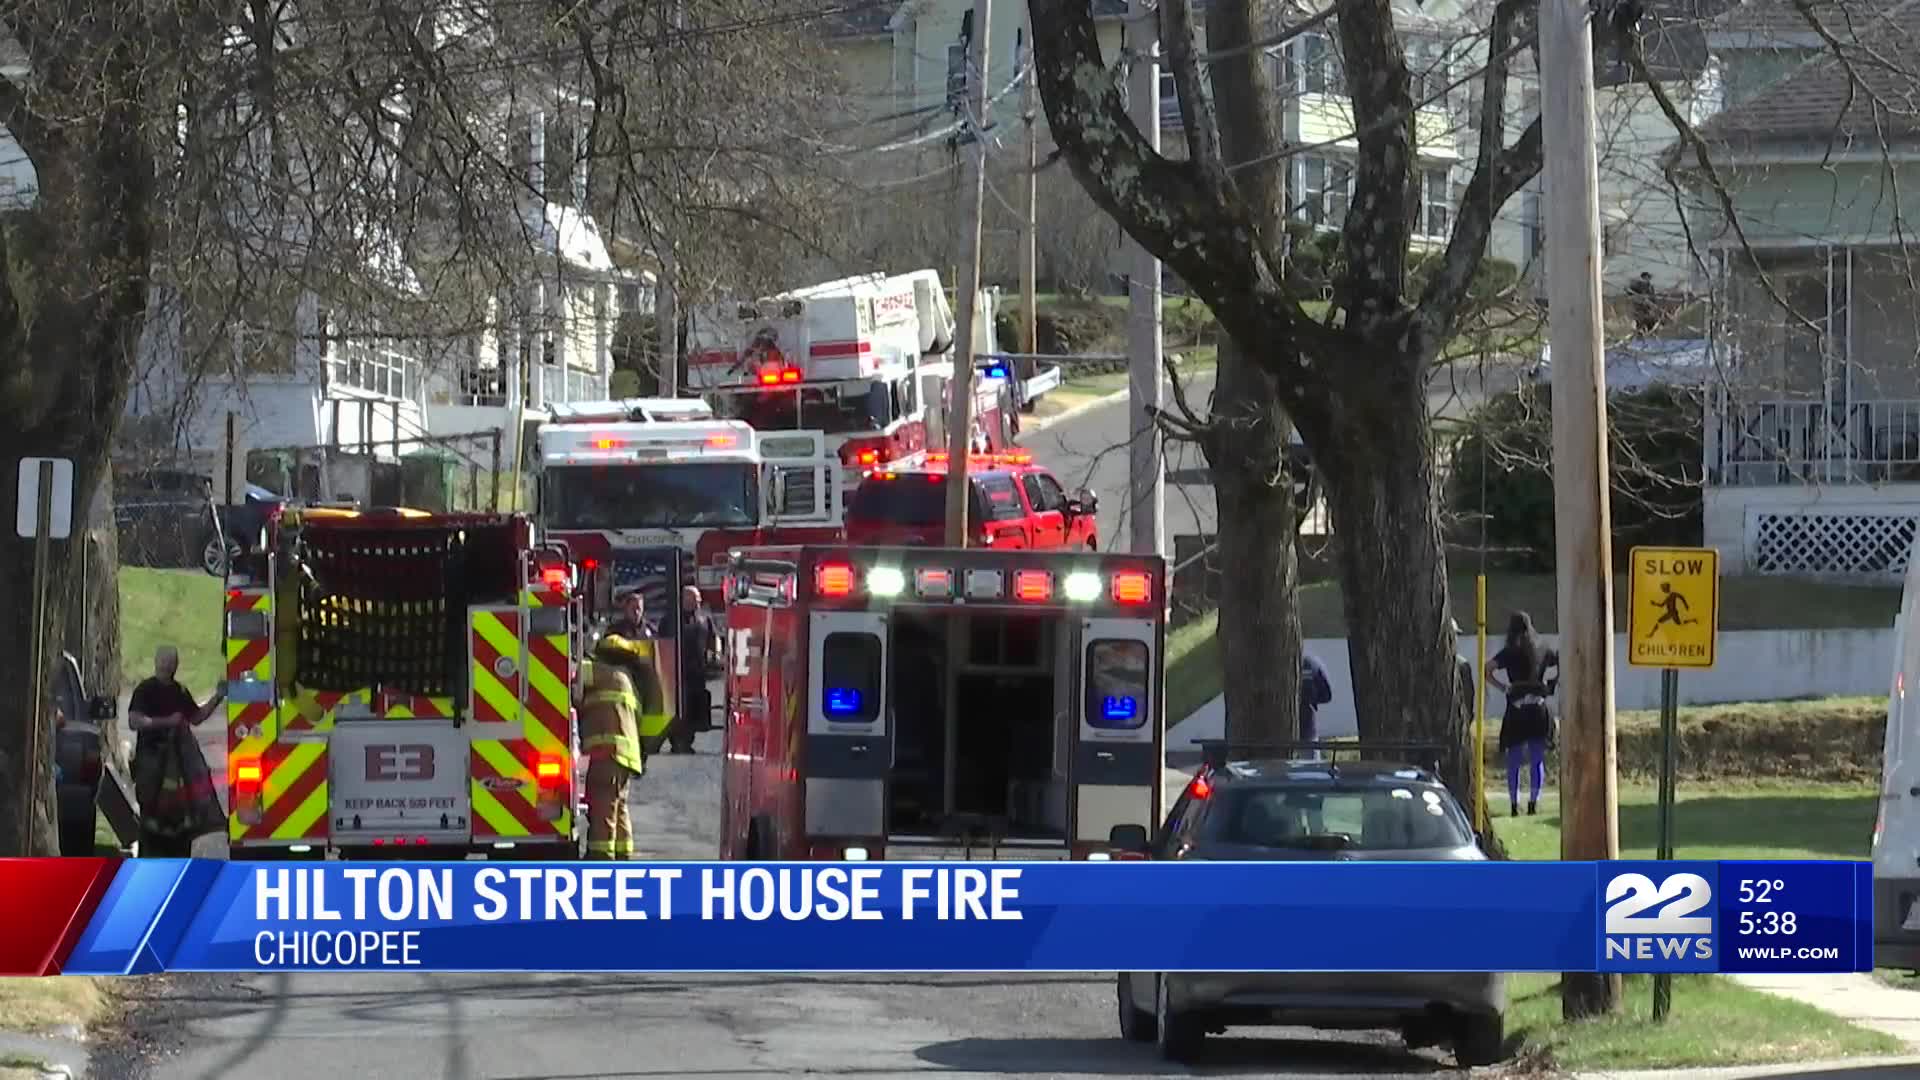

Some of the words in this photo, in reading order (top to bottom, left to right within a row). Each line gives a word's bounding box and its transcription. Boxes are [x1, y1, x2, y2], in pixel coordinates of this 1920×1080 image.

[1645, 559, 1703, 575] SLOW
[1637, 642, 1706, 657] CHILDREN
[364, 744, 436, 782] E3
[345, 798, 374, 809] KEEP
[376, 798, 406, 809] BACK
[429, 797, 456, 809] FEET
